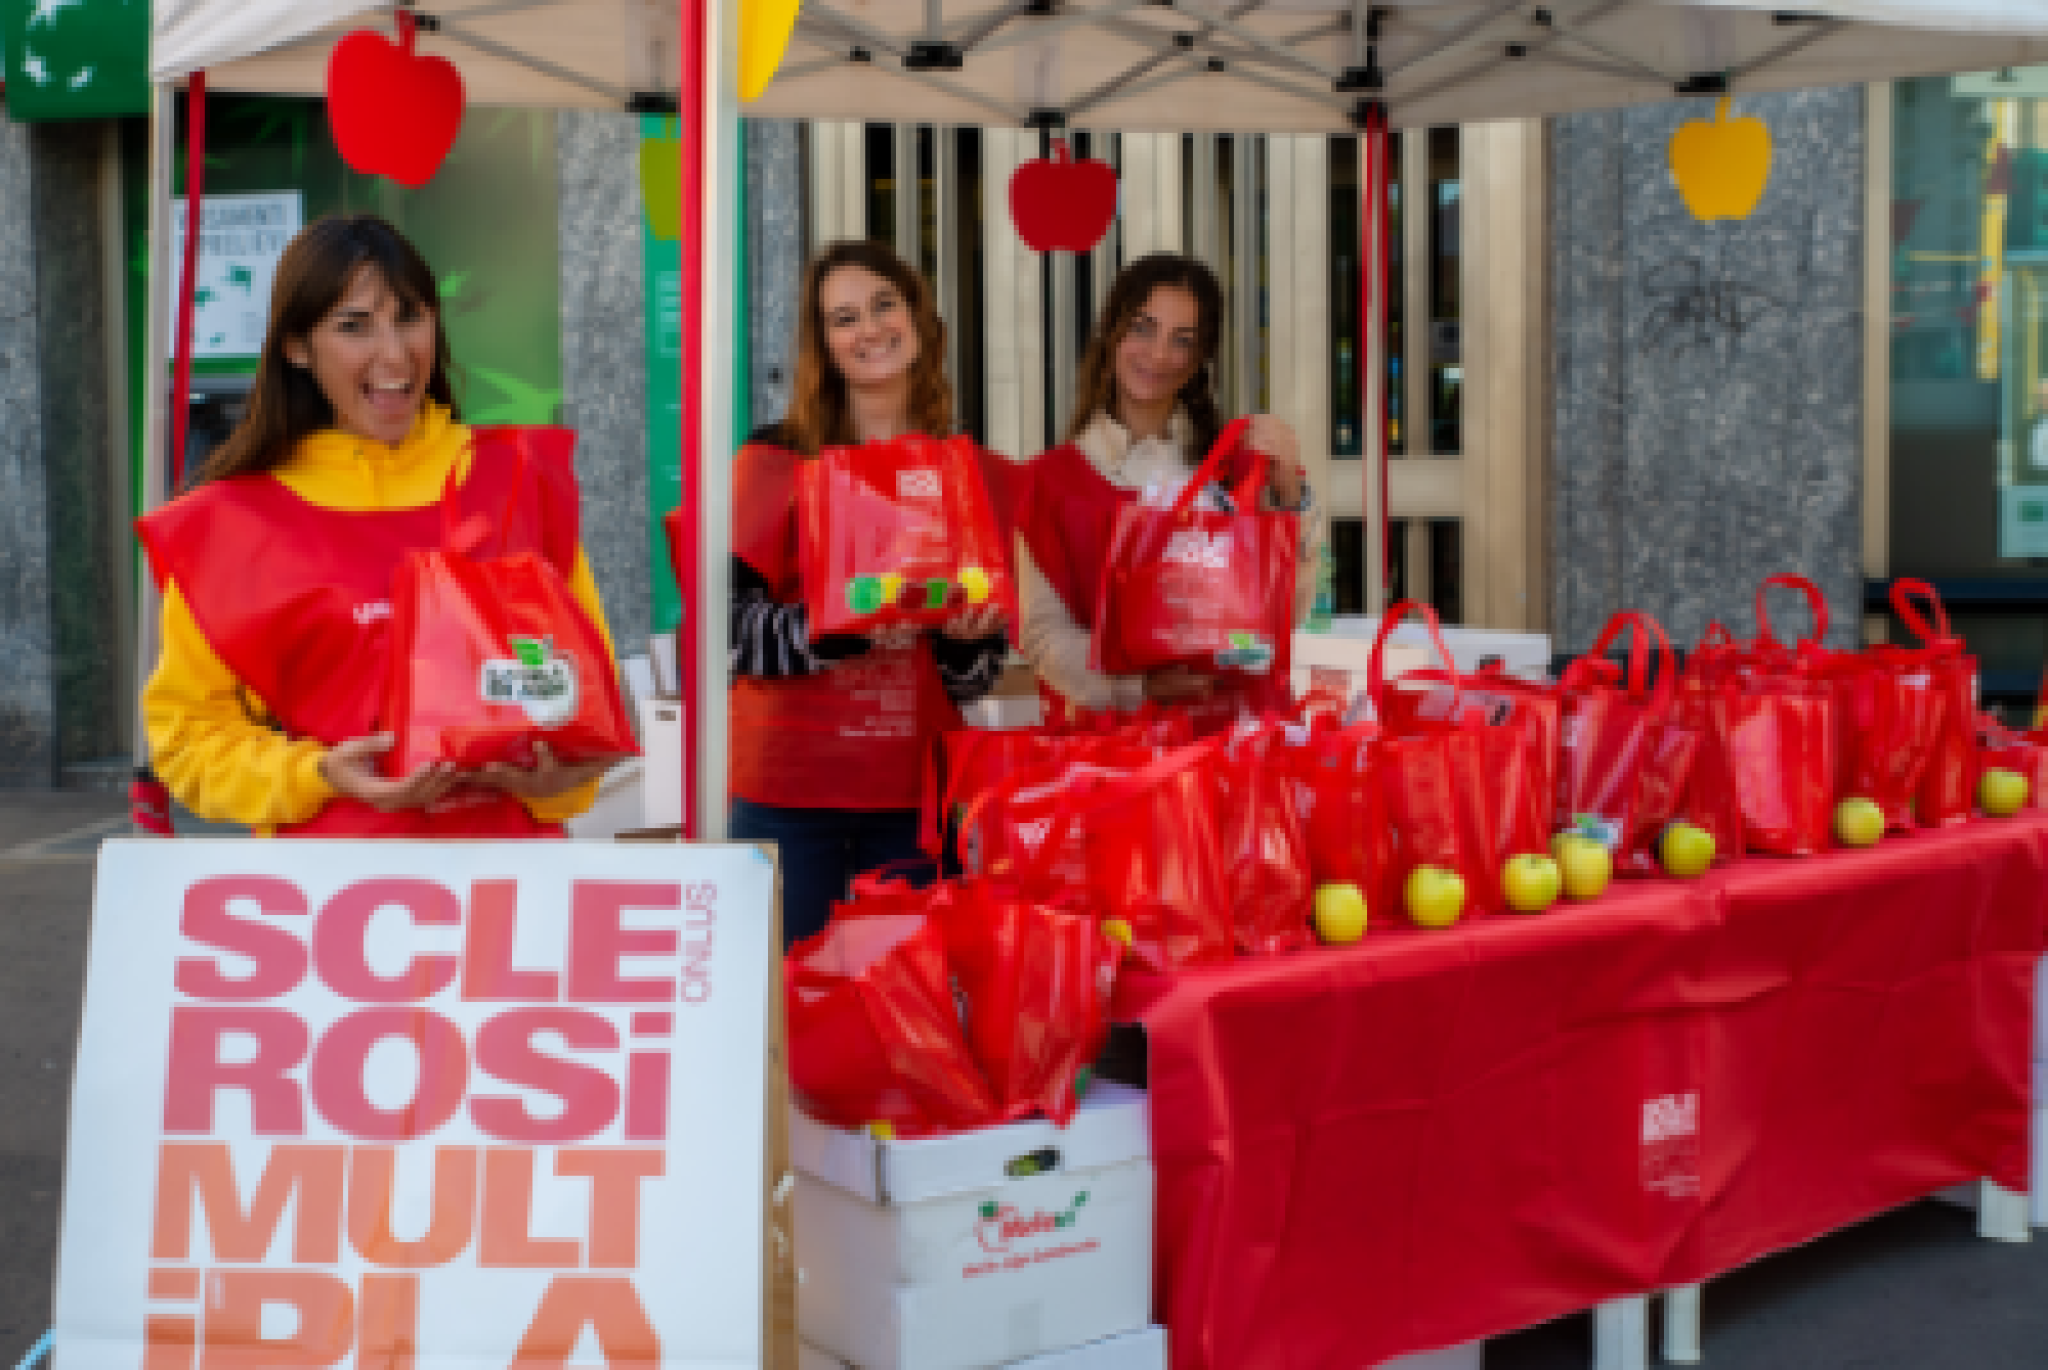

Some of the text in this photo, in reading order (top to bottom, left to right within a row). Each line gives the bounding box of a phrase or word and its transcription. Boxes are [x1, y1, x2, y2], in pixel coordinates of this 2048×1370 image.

[174, 874, 681, 1002] SCLE
[682, 880, 717, 1006] ONLUS
[150, 1142, 667, 1268] MULT
